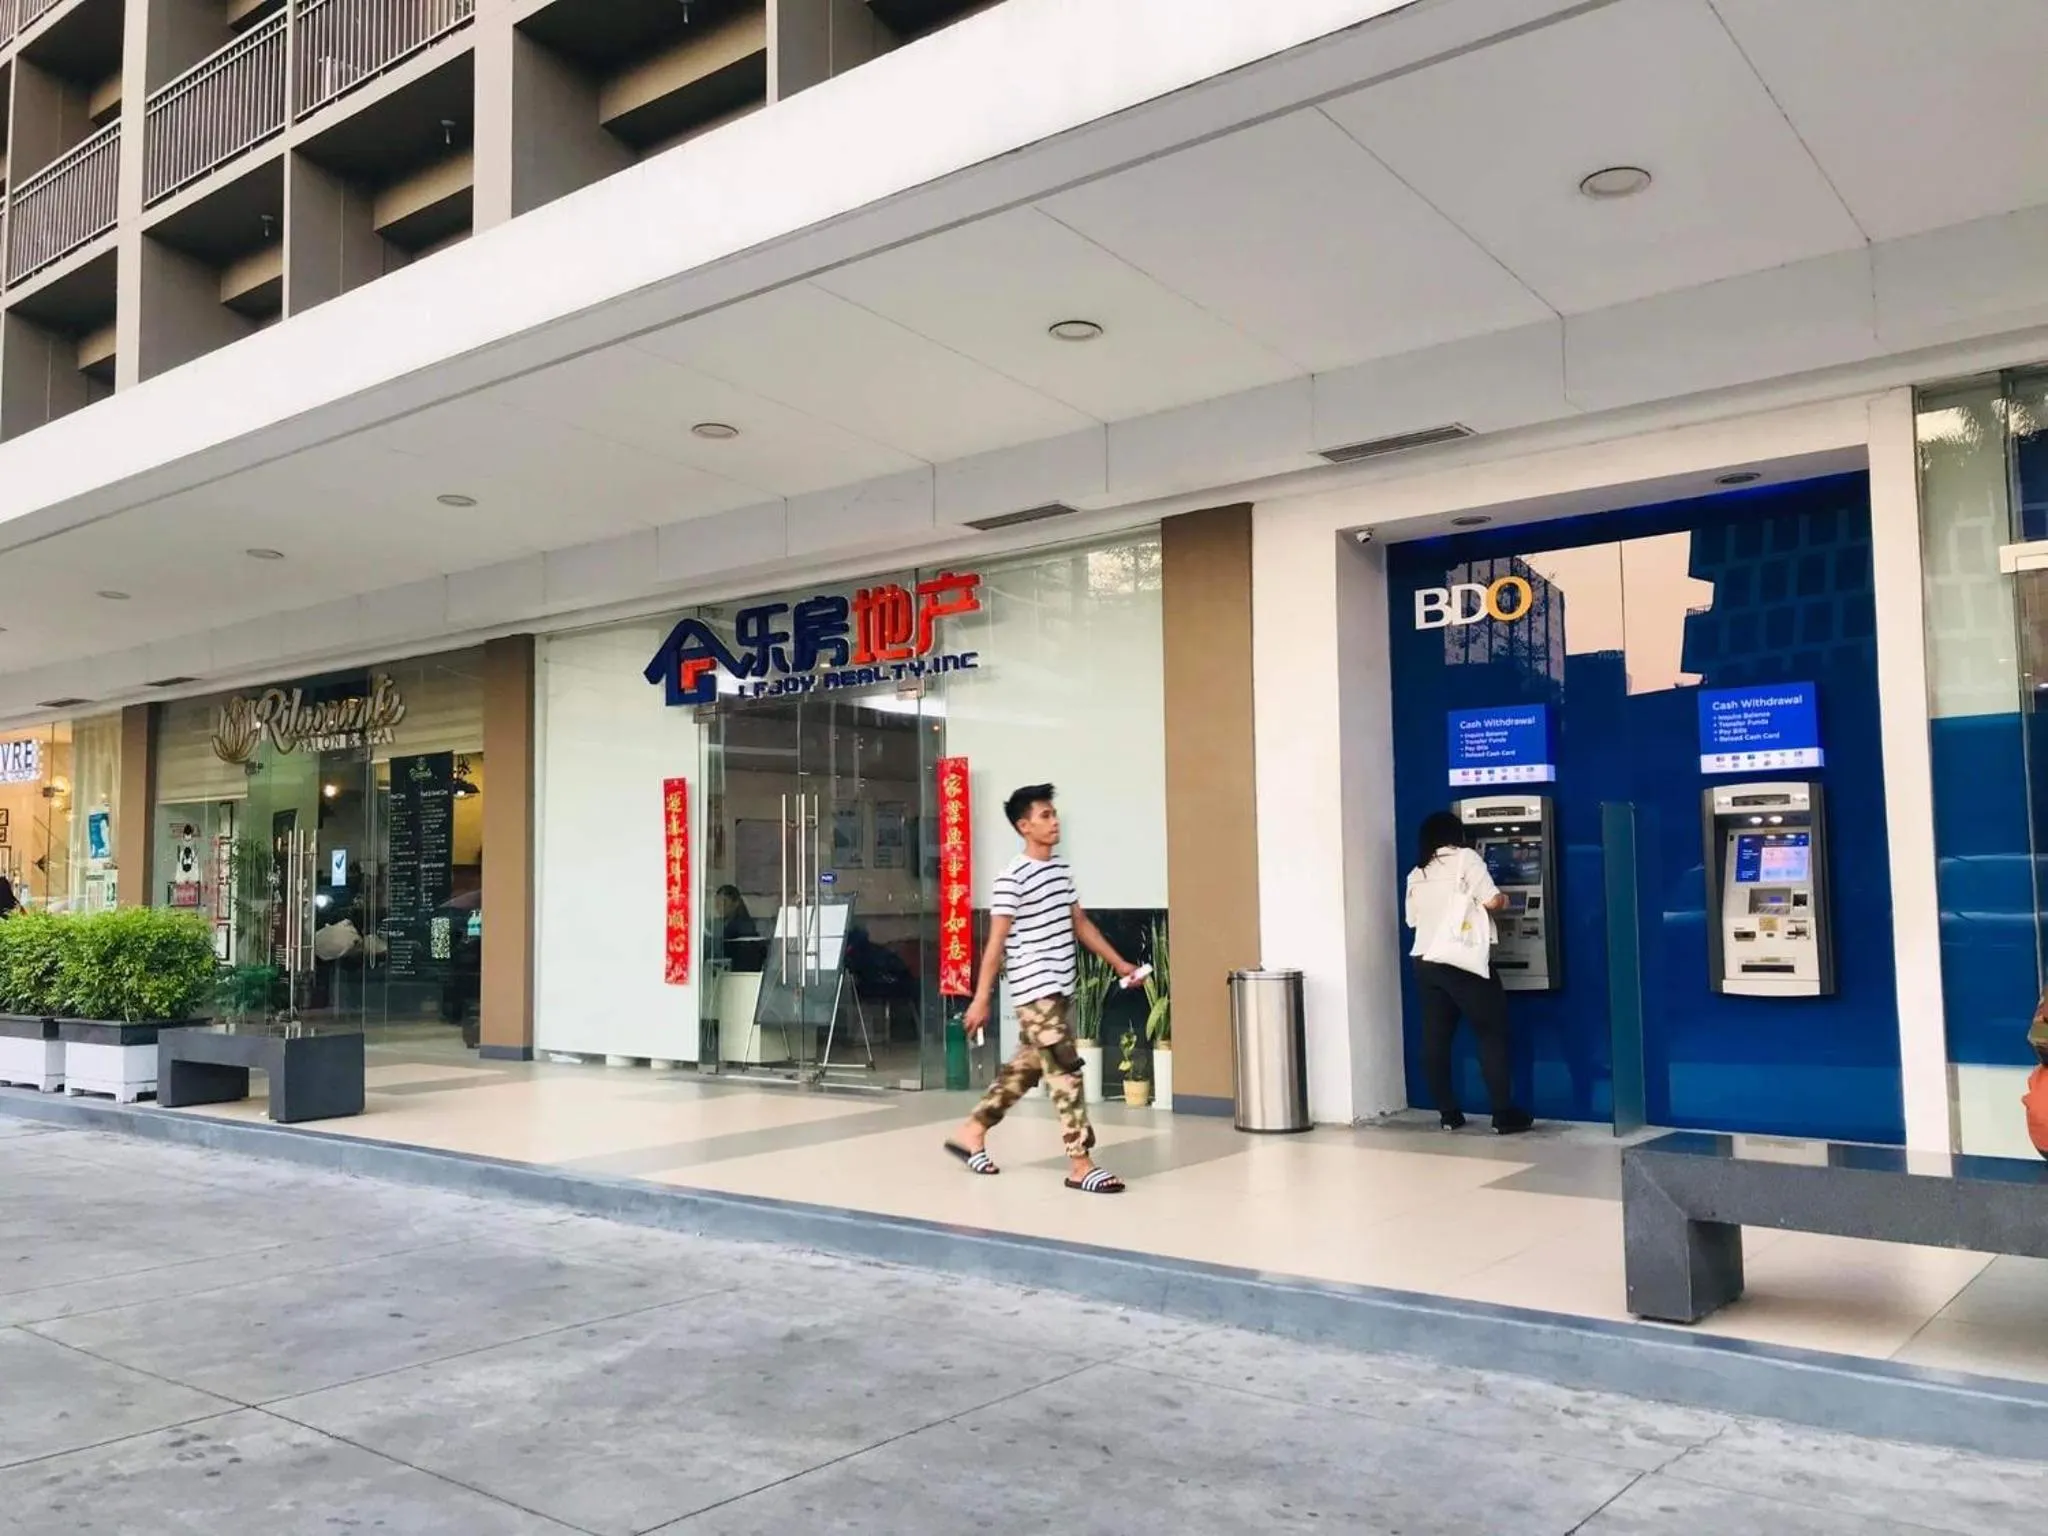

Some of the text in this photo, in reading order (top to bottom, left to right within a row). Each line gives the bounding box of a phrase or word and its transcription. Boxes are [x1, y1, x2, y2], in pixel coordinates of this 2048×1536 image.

[1415, 576, 1533, 630] BDO
[736, 571, 983, 677] 乐房地产
[1712, 694, 1803, 711] Cash Withdrawal
[1460, 716, 1536, 729] Cash Withdrawal
